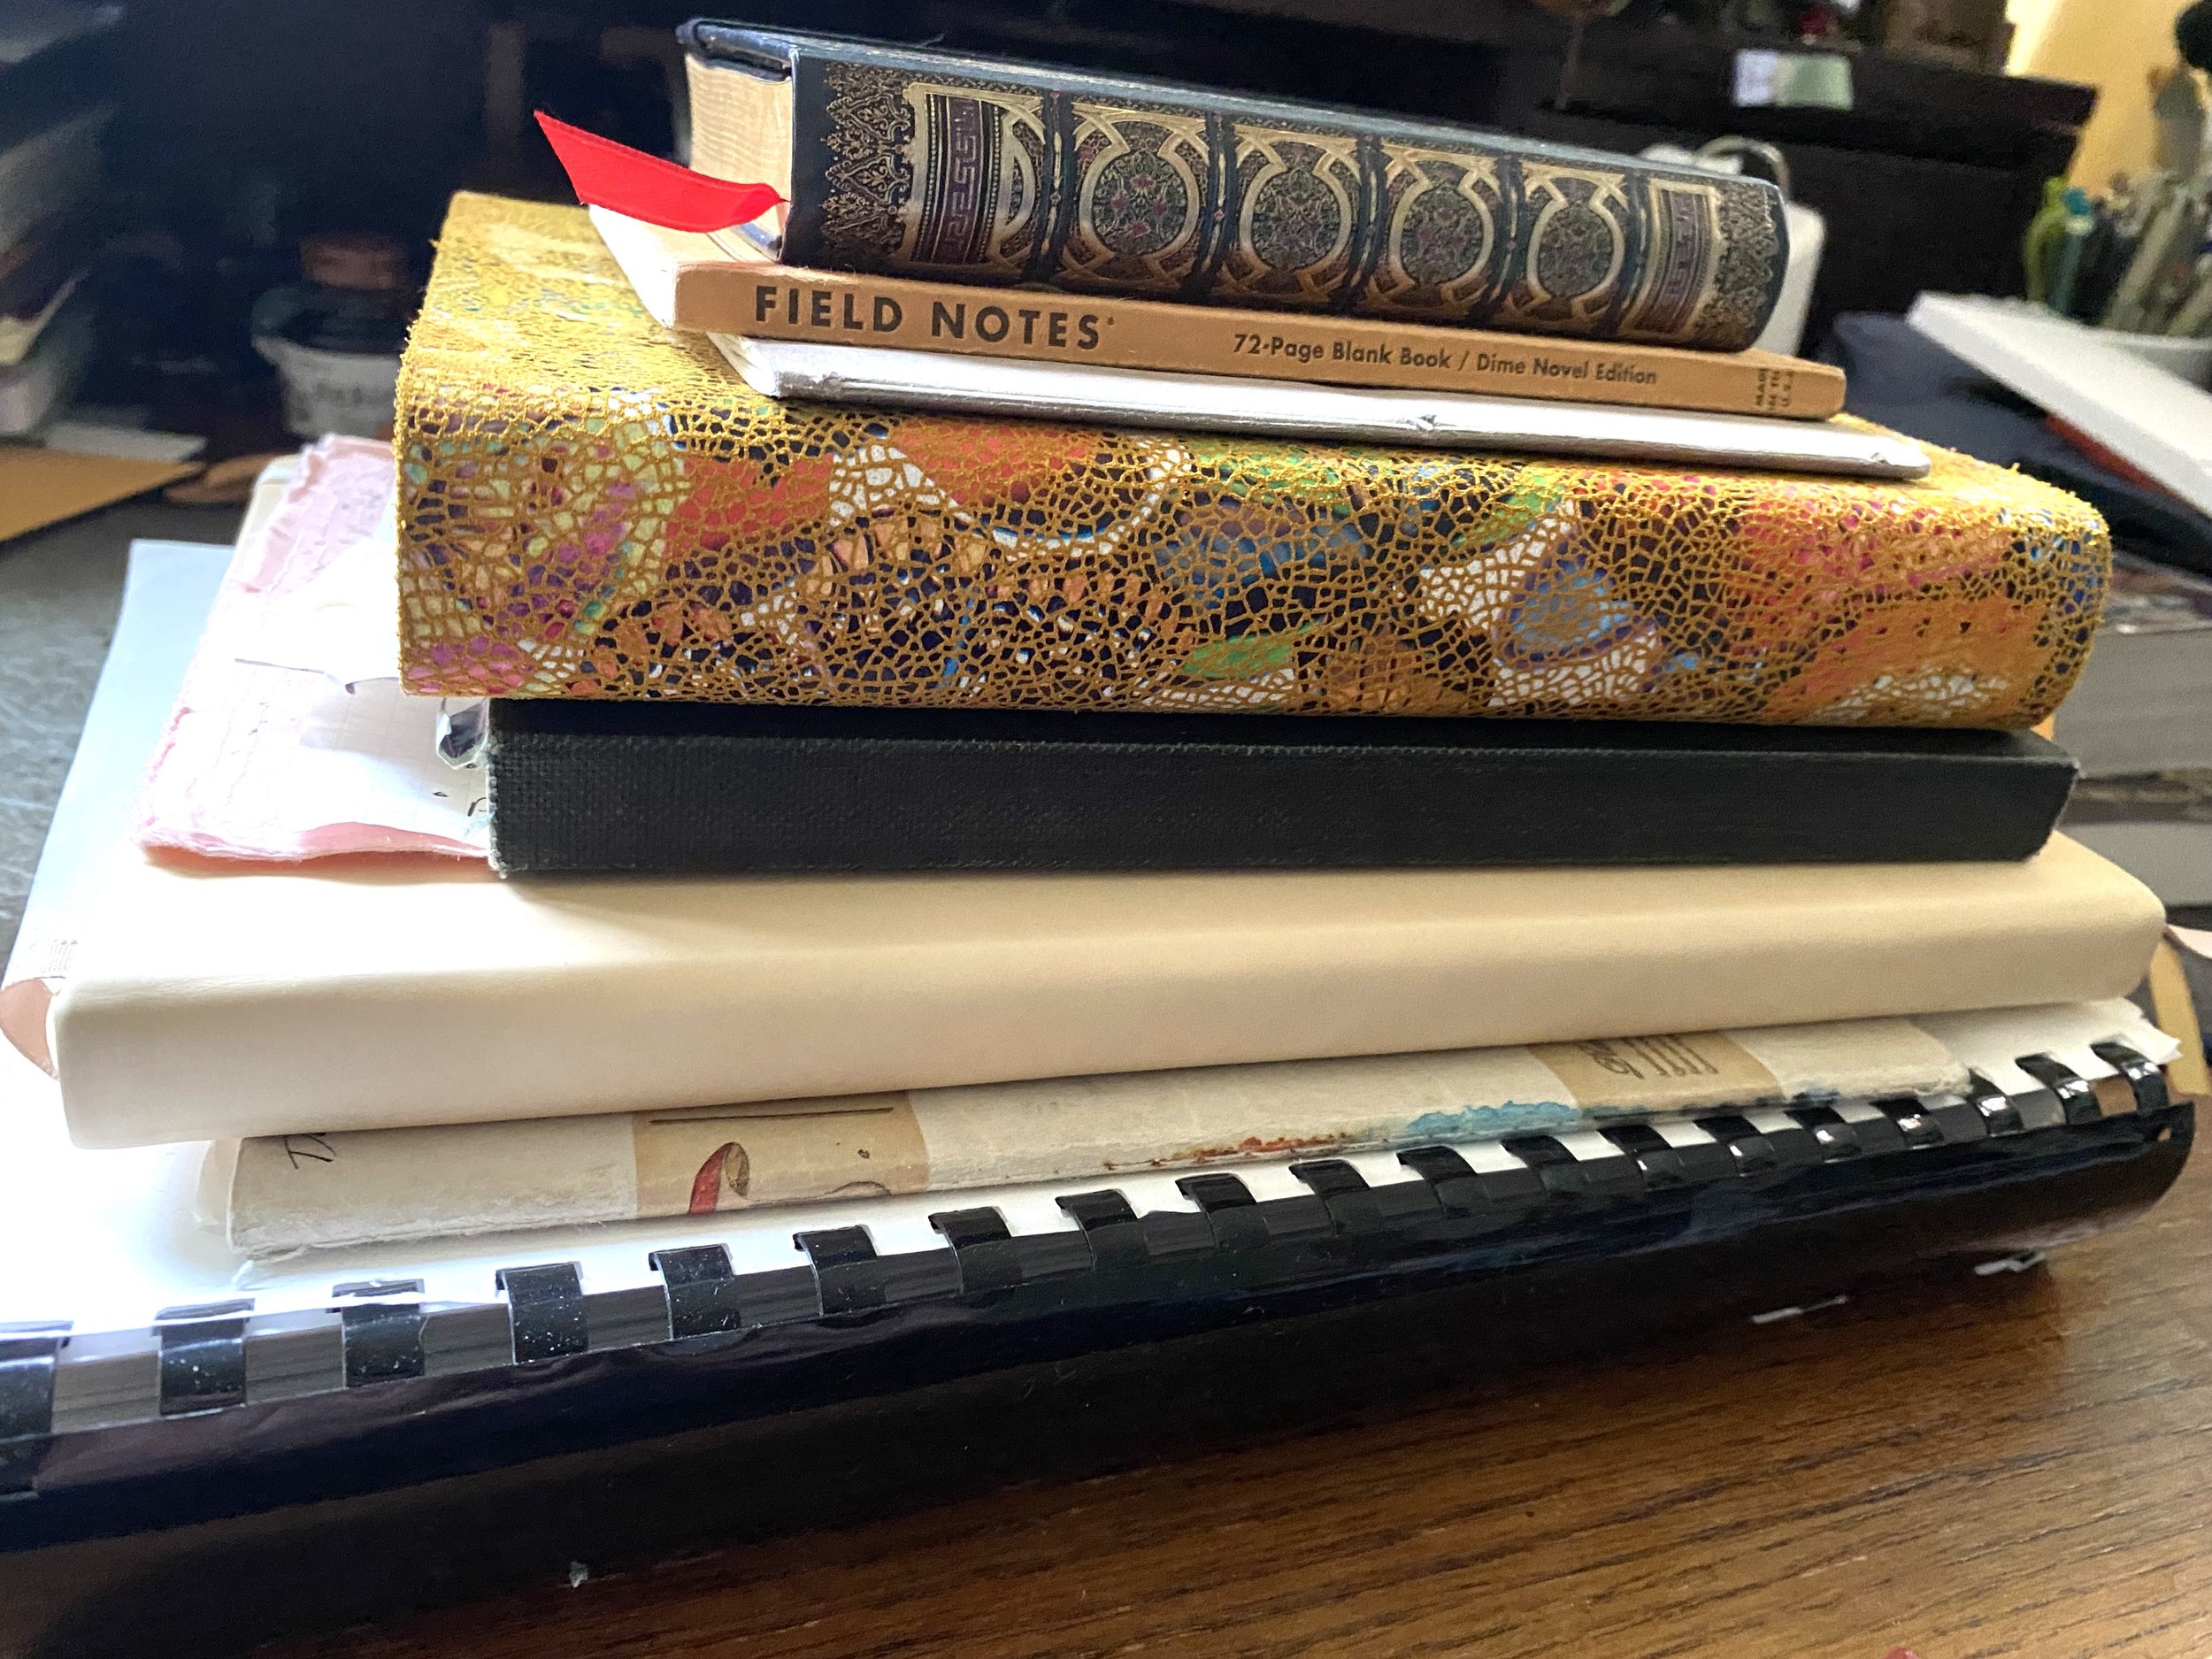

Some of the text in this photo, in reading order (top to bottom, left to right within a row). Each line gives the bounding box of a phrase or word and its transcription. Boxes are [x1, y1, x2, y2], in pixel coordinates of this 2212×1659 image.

[756, 285, 902, 333] FIELD
[1233, 333, 1325, 364] 72-Page
[1333, 341, 1392, 365] Blank
[1400, 345, 1450, 369] Book
[1477, 353, 1525, 374] Dime
[1532, 357, 1590, 379] Novel
[1595, 363, 1657, 385] Edition
